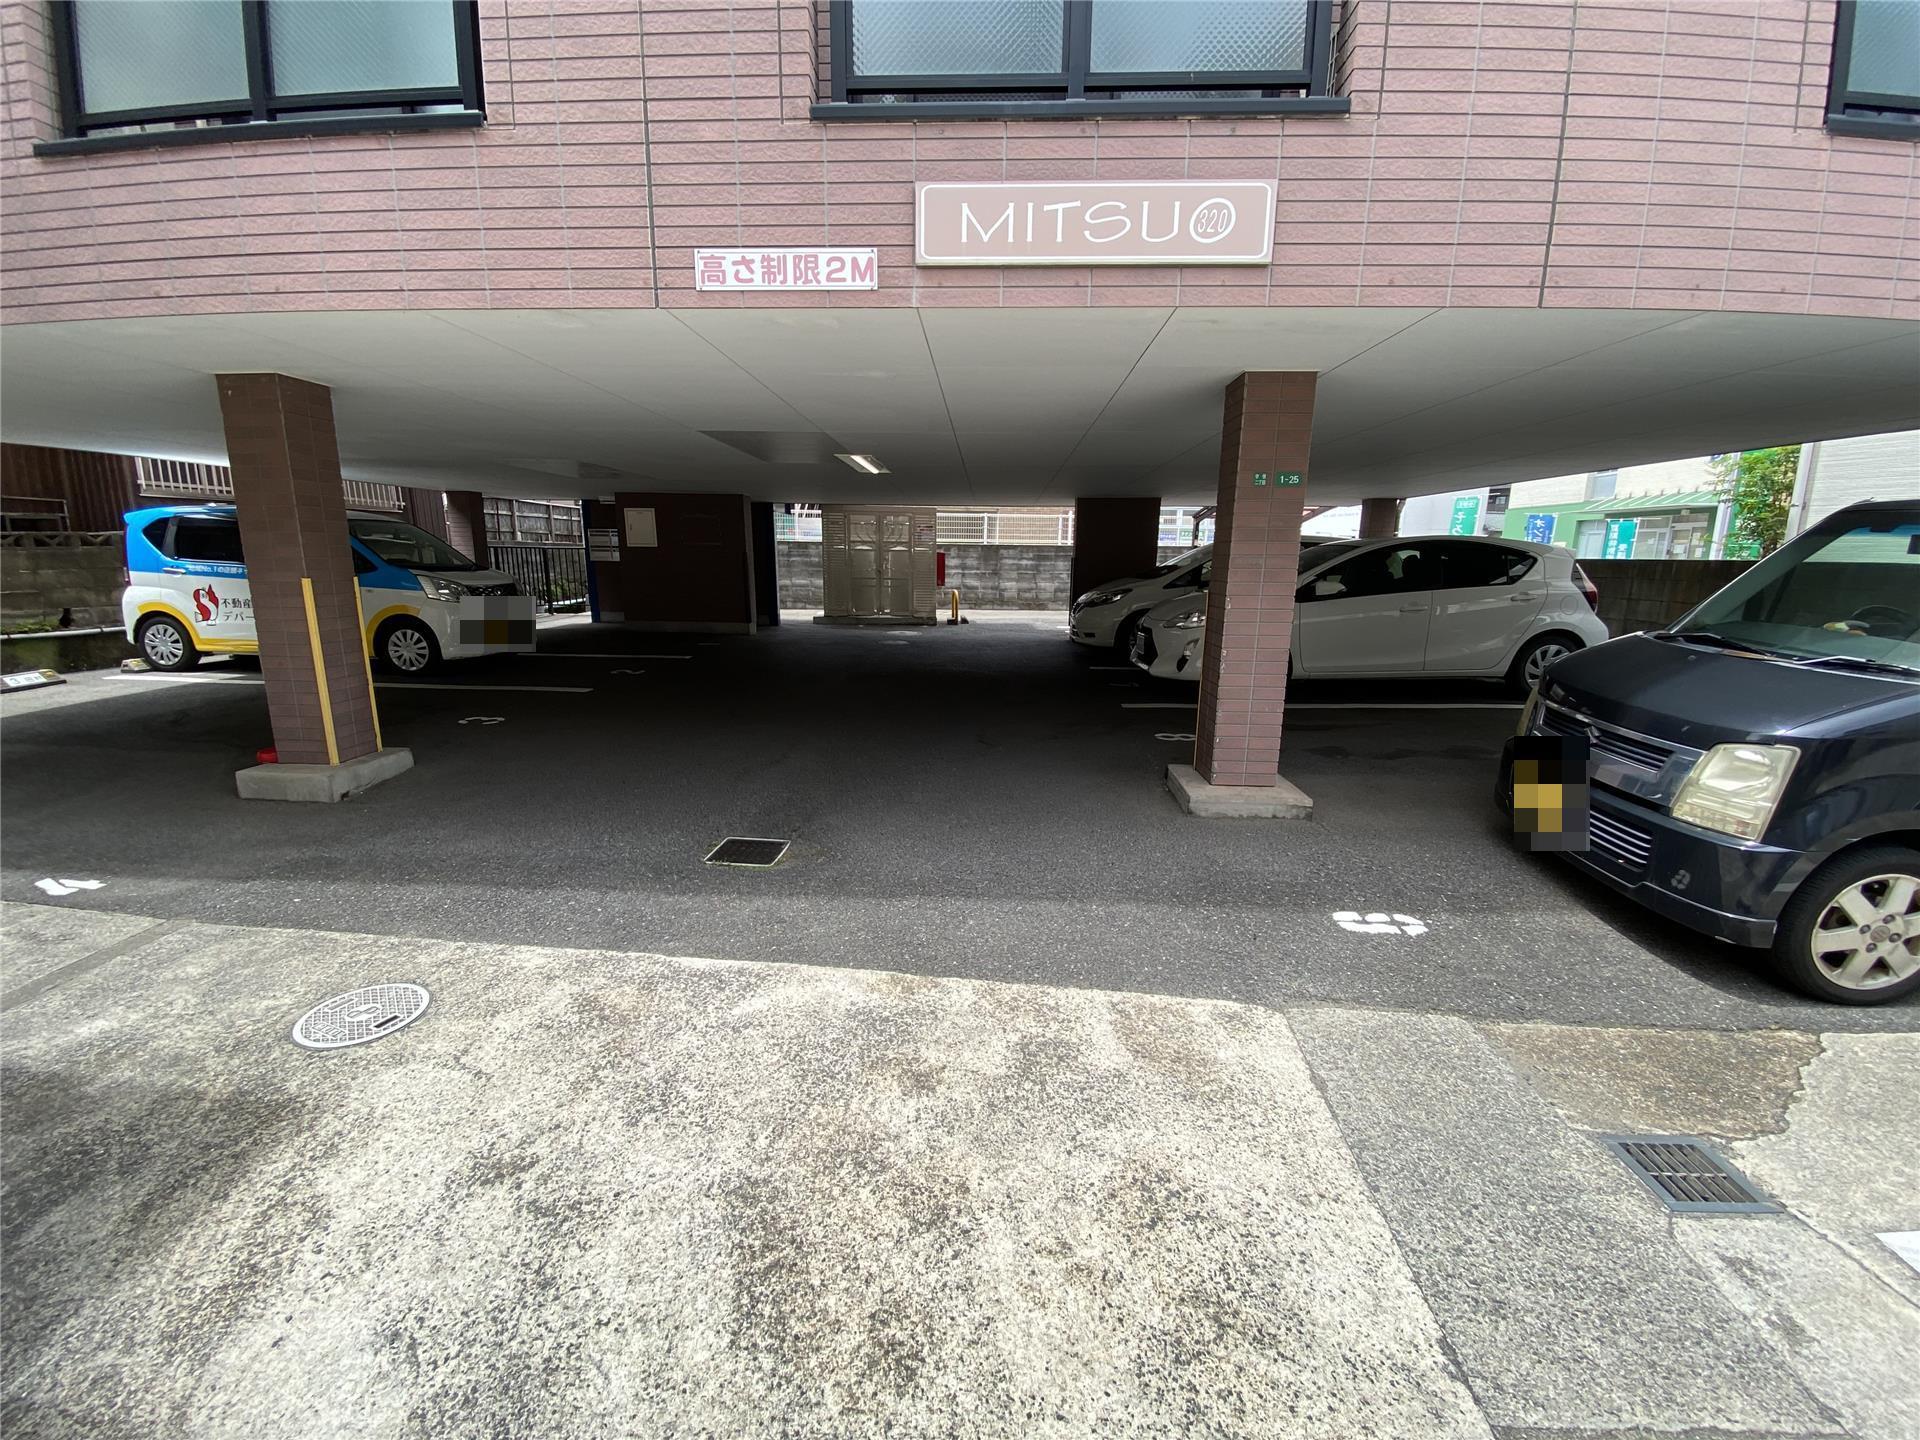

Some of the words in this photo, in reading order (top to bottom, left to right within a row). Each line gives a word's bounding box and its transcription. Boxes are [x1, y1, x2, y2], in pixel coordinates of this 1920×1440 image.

[699, 254, 875, 285] 高さ制限2M
[1280, 475, 1299, 484] 1-25
